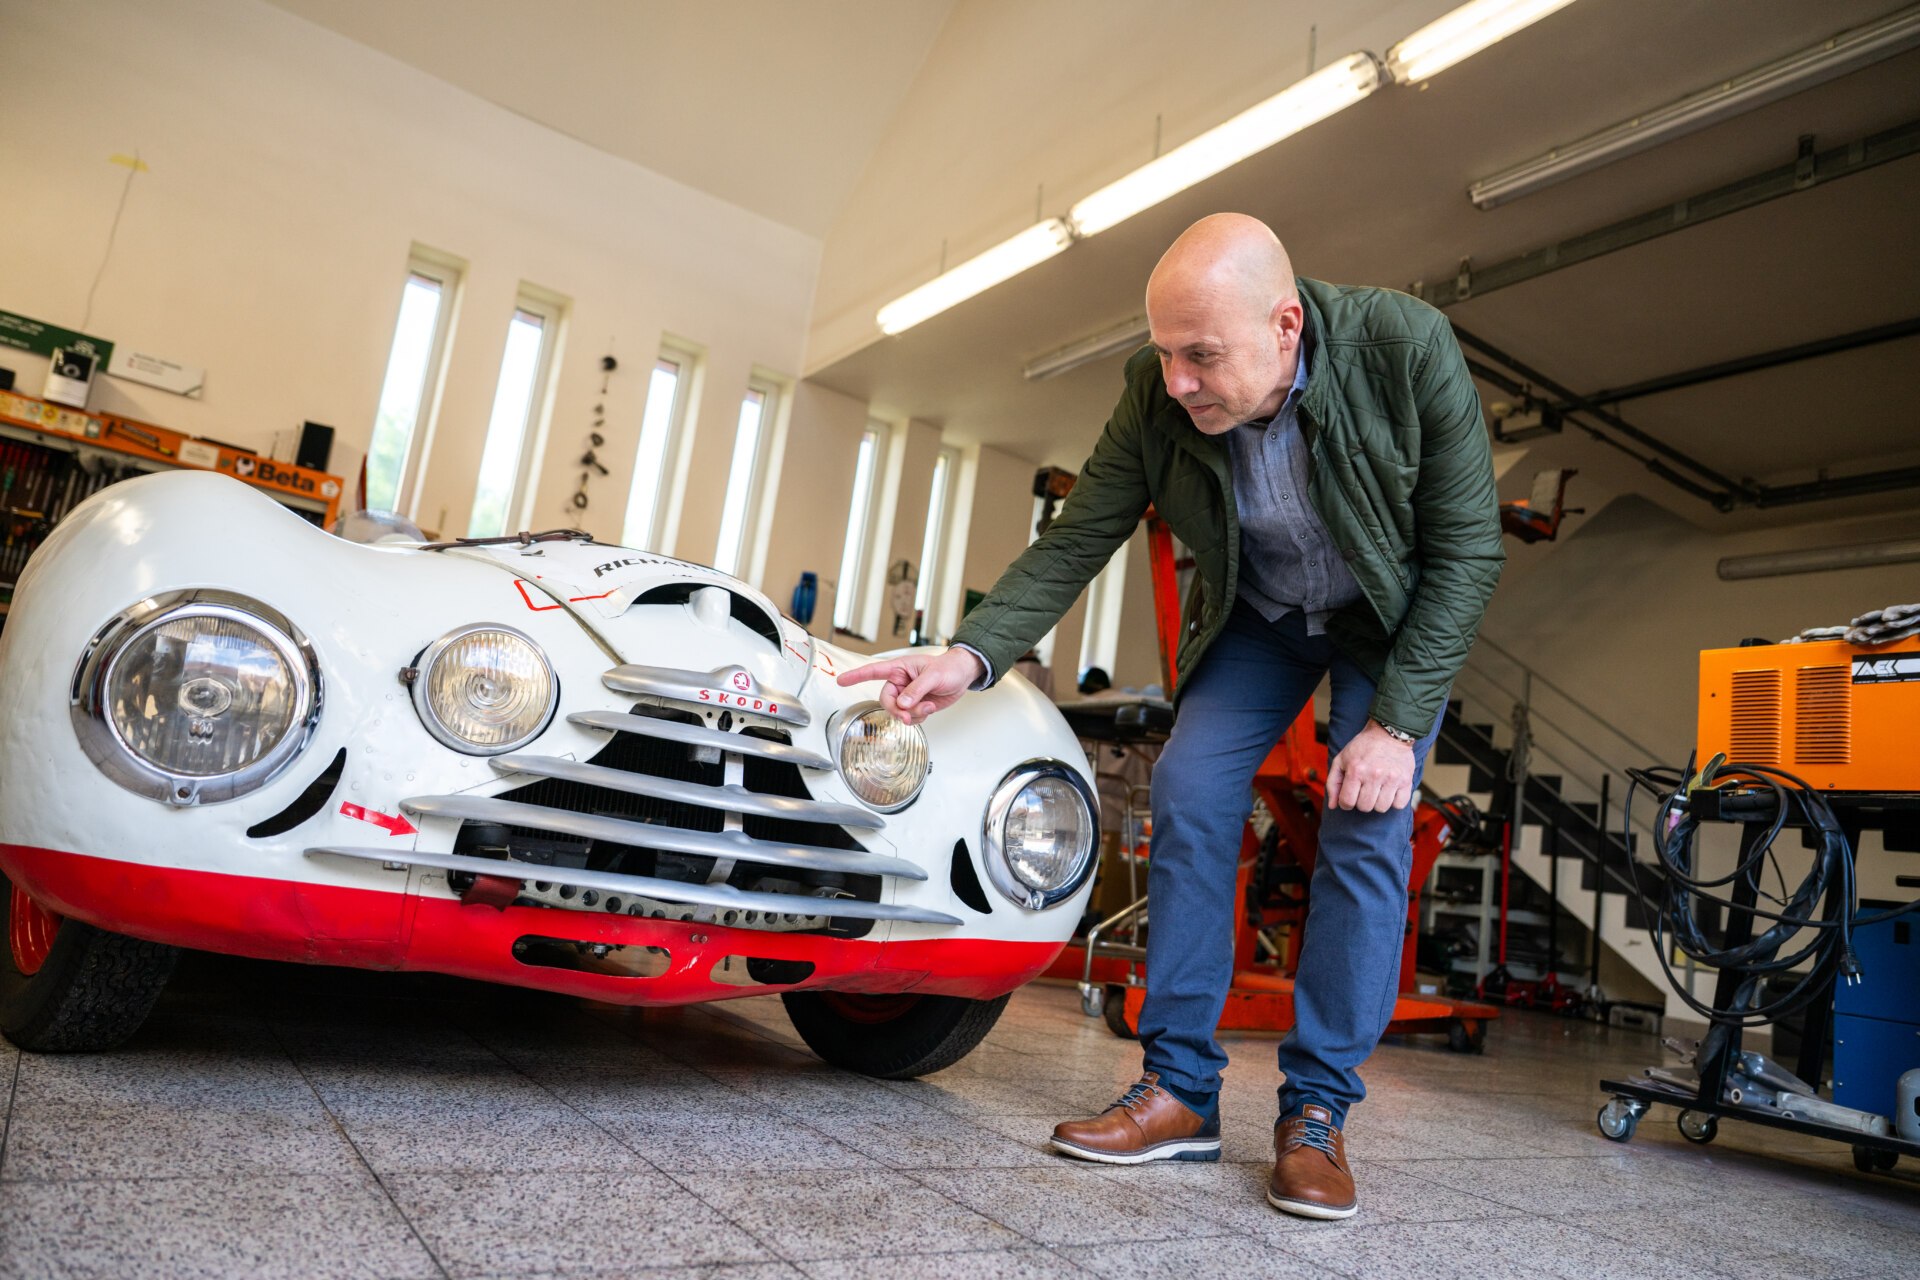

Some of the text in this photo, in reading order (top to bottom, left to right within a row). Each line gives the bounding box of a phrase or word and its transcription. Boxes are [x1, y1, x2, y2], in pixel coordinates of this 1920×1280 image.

[258, 463, 315, 492] Beta
[593, 558, 718, 578] RICHA
[698, 689, 778, 714] SKODA
